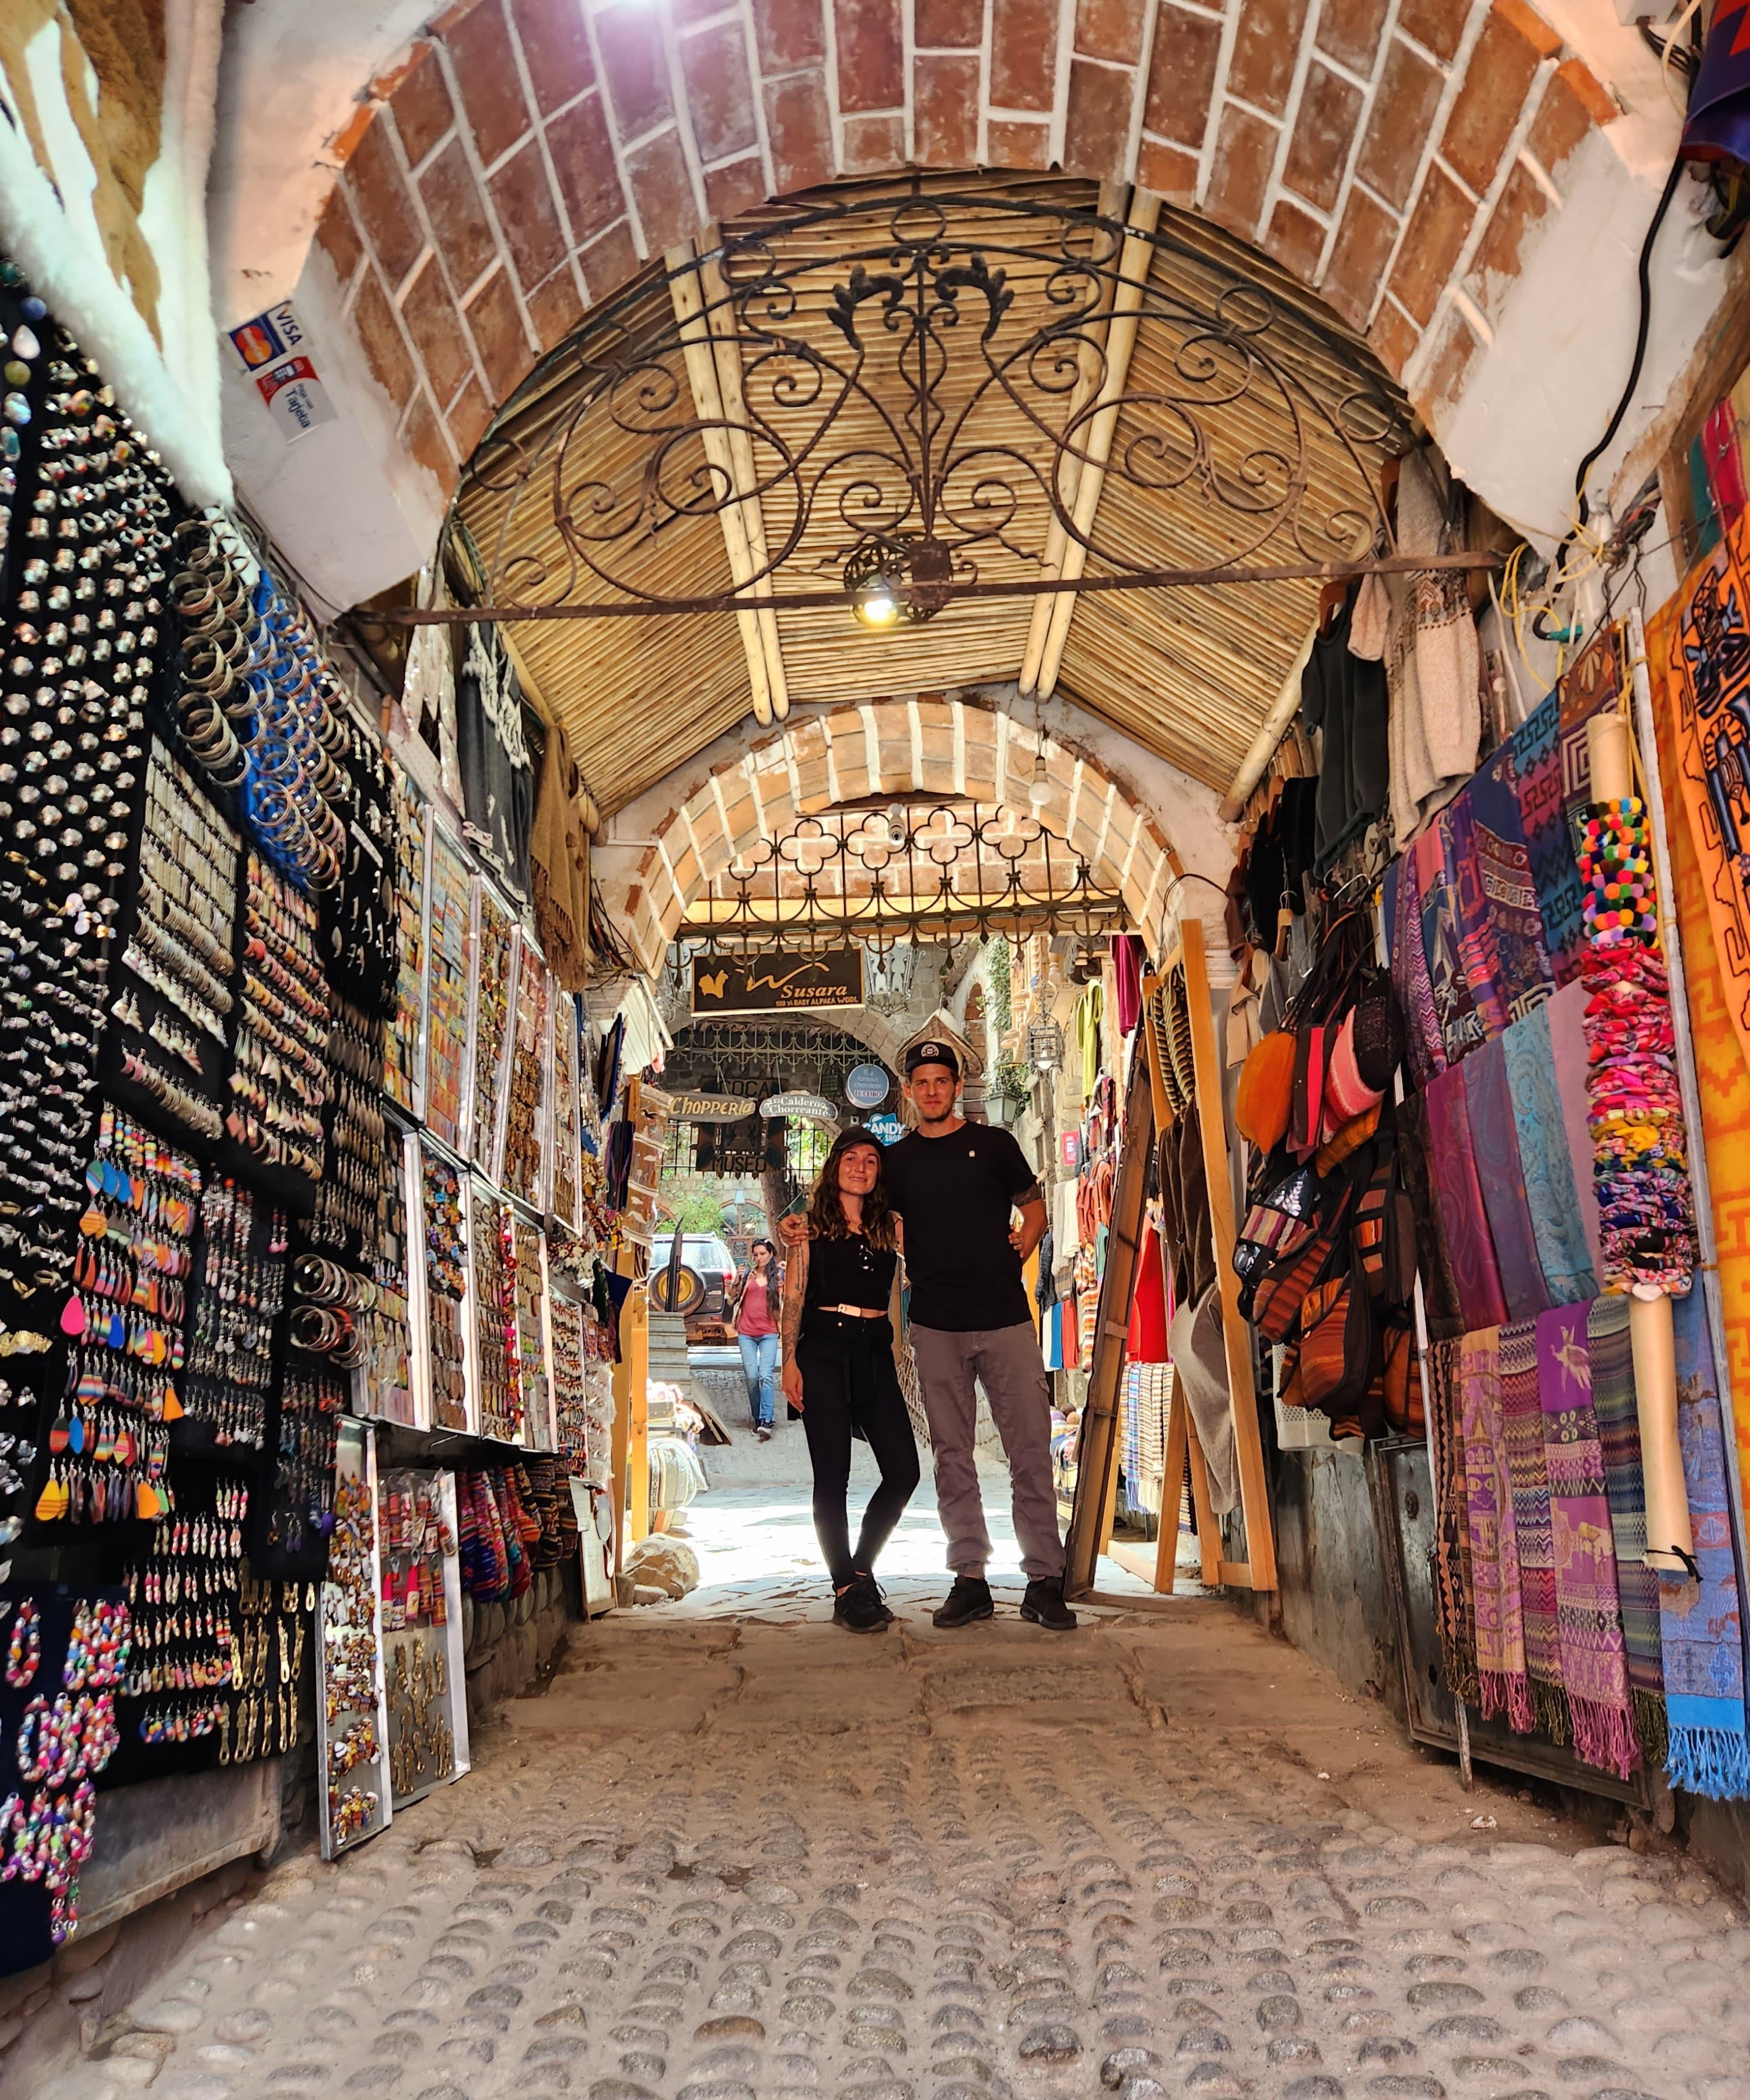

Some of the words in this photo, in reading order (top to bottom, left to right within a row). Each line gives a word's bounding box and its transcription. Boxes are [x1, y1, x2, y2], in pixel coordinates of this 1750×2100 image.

[276, 307, 303, 345] VISA
[285, 387, 312, 429] Tarjeta
[780, 985, 848, 998] Susara
[780, 1097, 820, 1108] Caldero
[885, 1134, 901, 1142] SHOP
[712, 1155, 767, 1172] MUSEO
